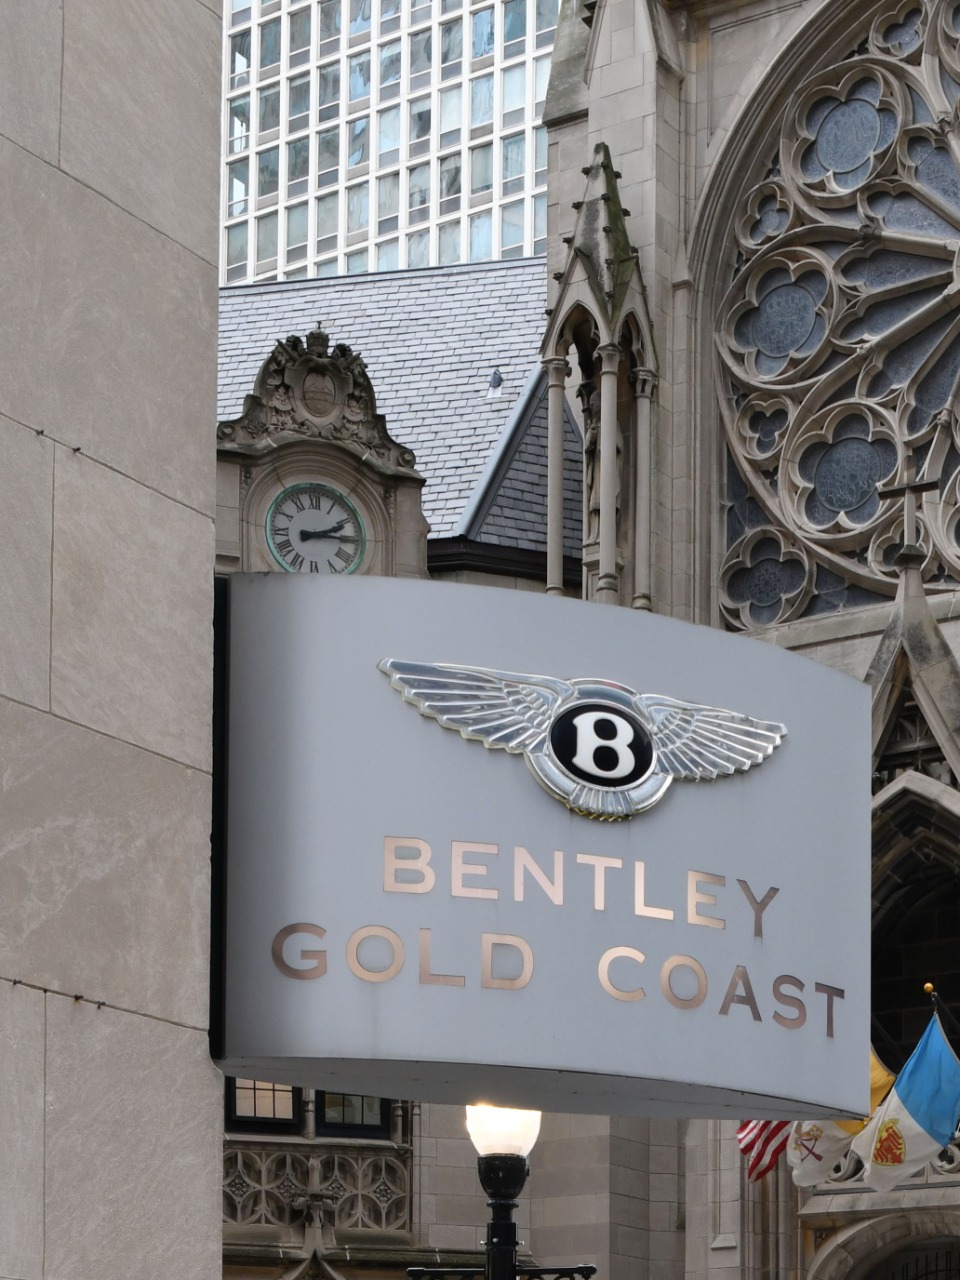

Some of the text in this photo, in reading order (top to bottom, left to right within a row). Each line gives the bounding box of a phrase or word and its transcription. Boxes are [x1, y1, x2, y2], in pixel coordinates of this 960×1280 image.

[572, 710, 637, 780] B
[383, 835, 780, 938] BENTLEY
[271, 922, 845, 1038] GOLD COAST
